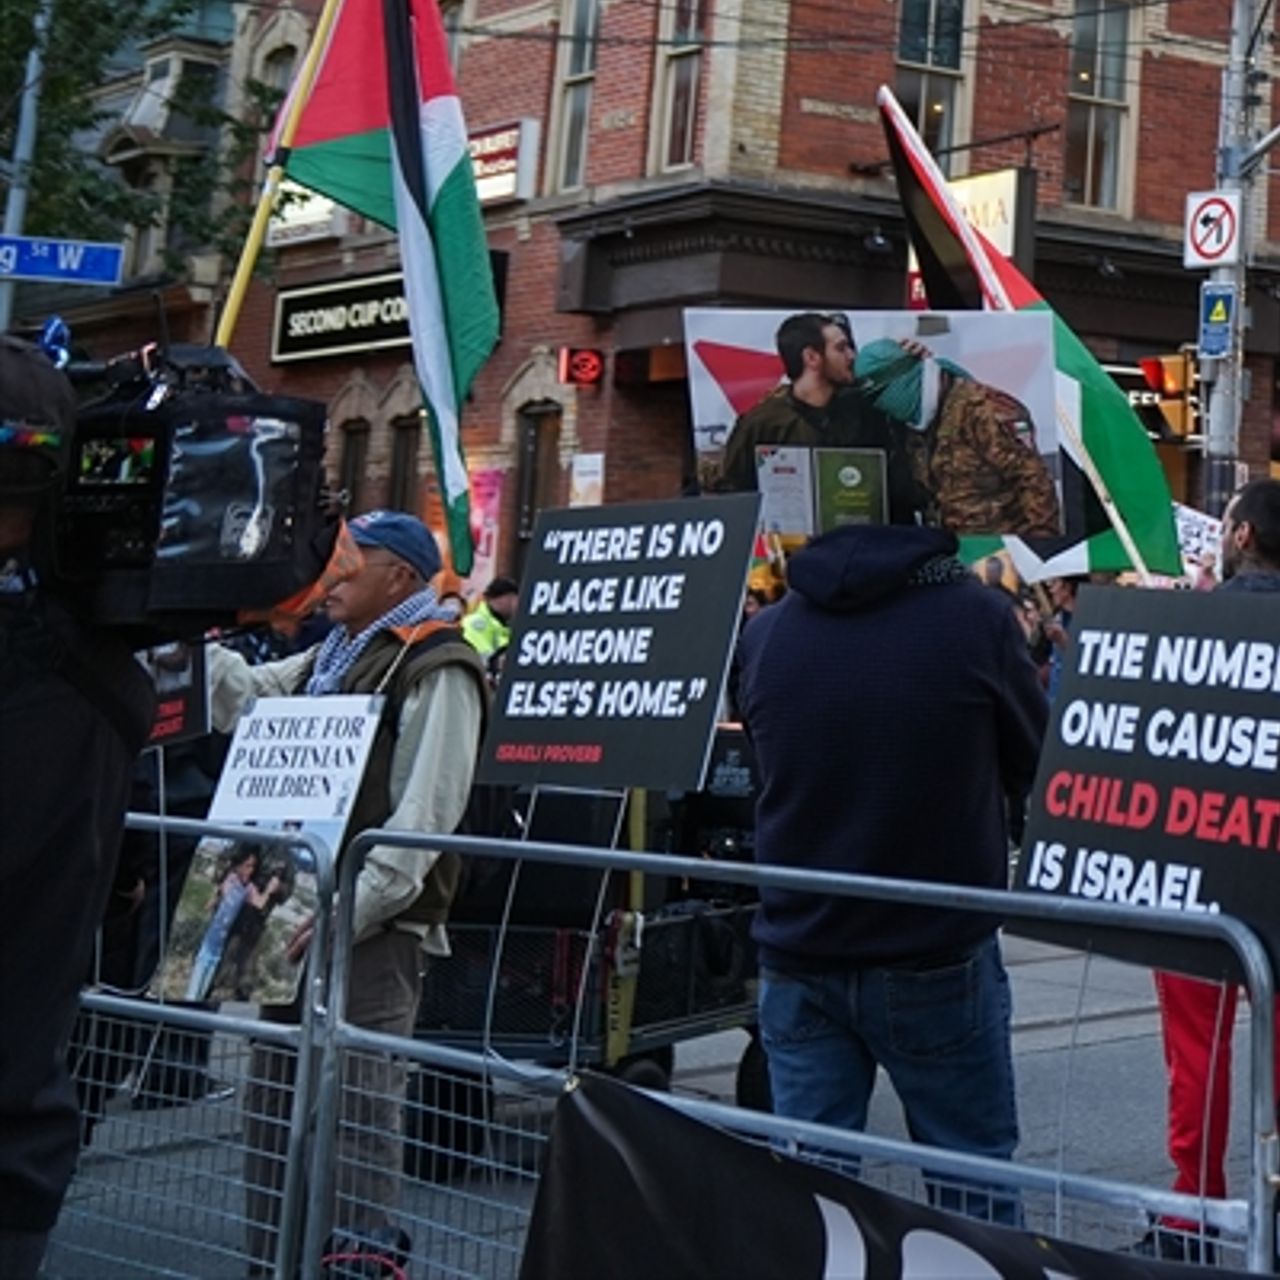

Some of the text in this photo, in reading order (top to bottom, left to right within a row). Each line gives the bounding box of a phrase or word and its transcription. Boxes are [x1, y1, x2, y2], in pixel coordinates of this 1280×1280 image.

[58, 245, 84, 271] W
[288, 296, 409, 337] SECOND CUP CO
[646, 523, 676, 559] IS
[678, 519, 725, 557] NO
[530, 573, 685, 615] PLACE LIKE
[518, 627, 653, 666] SOMEONE
[1078, 630, 1148, 679] THE
[242, 716, 366, 741] JUSTICE FOR
[1060, 699, 1140, 752] ONE
[232, 745, 359, 769] PALESTINIAN
[496, 744, 603, 762] ISRAELI PROVERB
[236, 775, 335, 799] CHILDREN
[1045, 770, 1159, 829] CHILD
[1027, 841, 1221, 914] IS ISRAEL.
